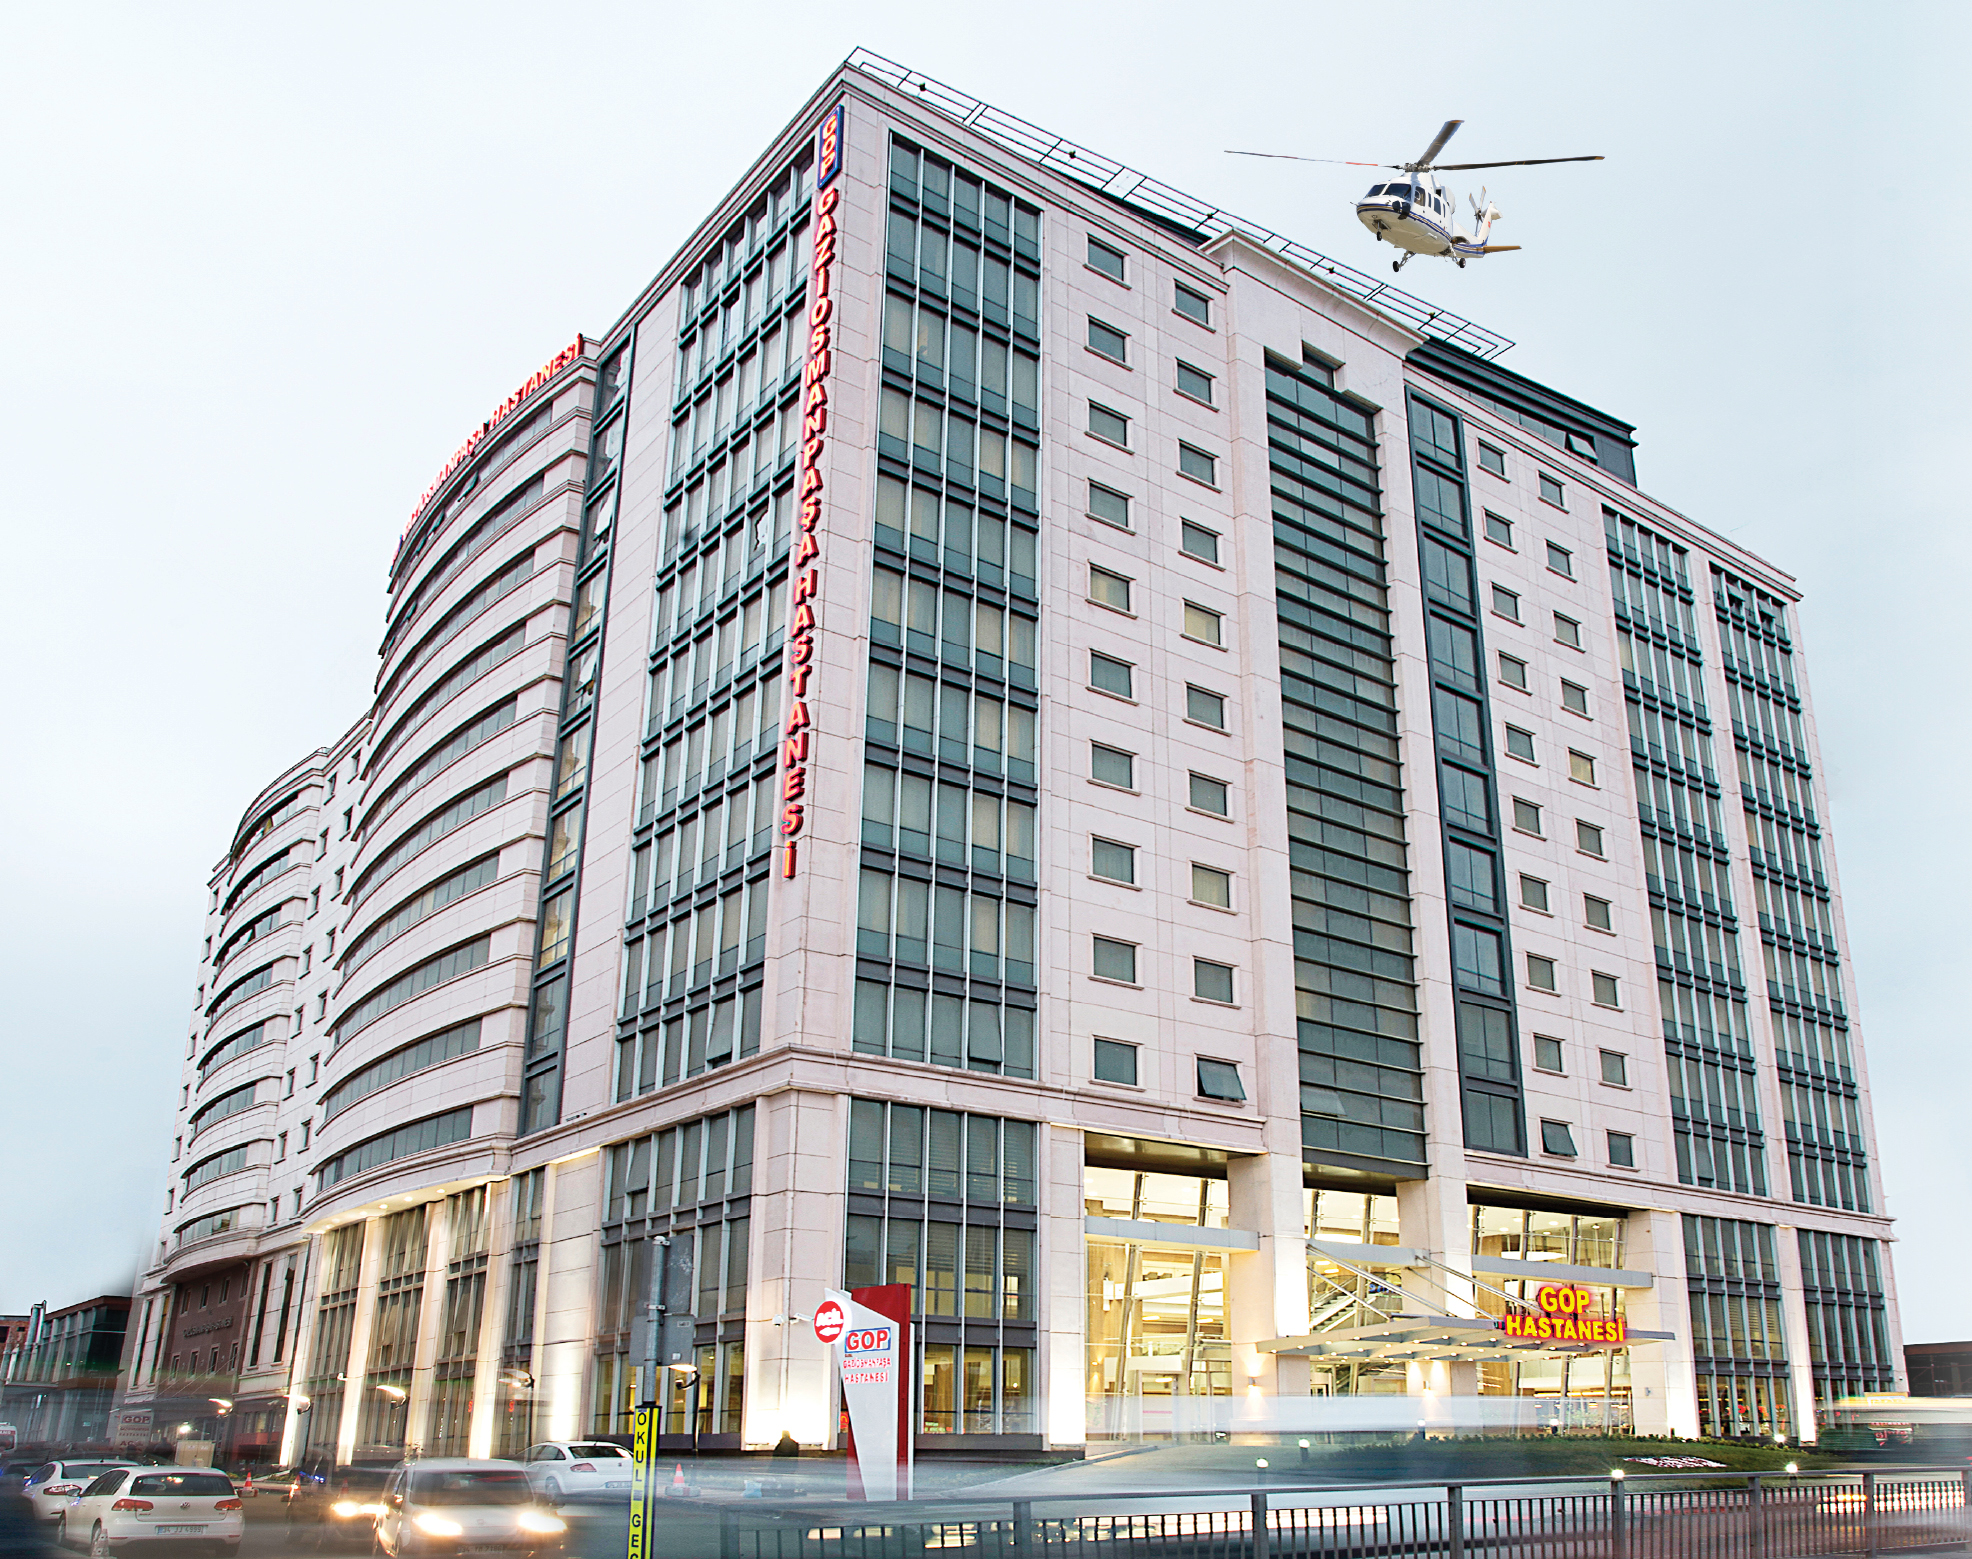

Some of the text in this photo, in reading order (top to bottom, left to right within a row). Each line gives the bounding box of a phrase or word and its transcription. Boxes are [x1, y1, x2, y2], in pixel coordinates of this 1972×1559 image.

[820, 114, 838, 182] GOP
[781, 567, 818, 879] HASTANESİ
[1539, 1286, 1590, 1313] GOP
[847, 1329, 888, 1351] GOP
[1505, 1314, 1625, 1341] HASTANESİ
[844, 1370, 889, 1384] HASTANESİ
[635, 1412, 647, 1483] OKUL
